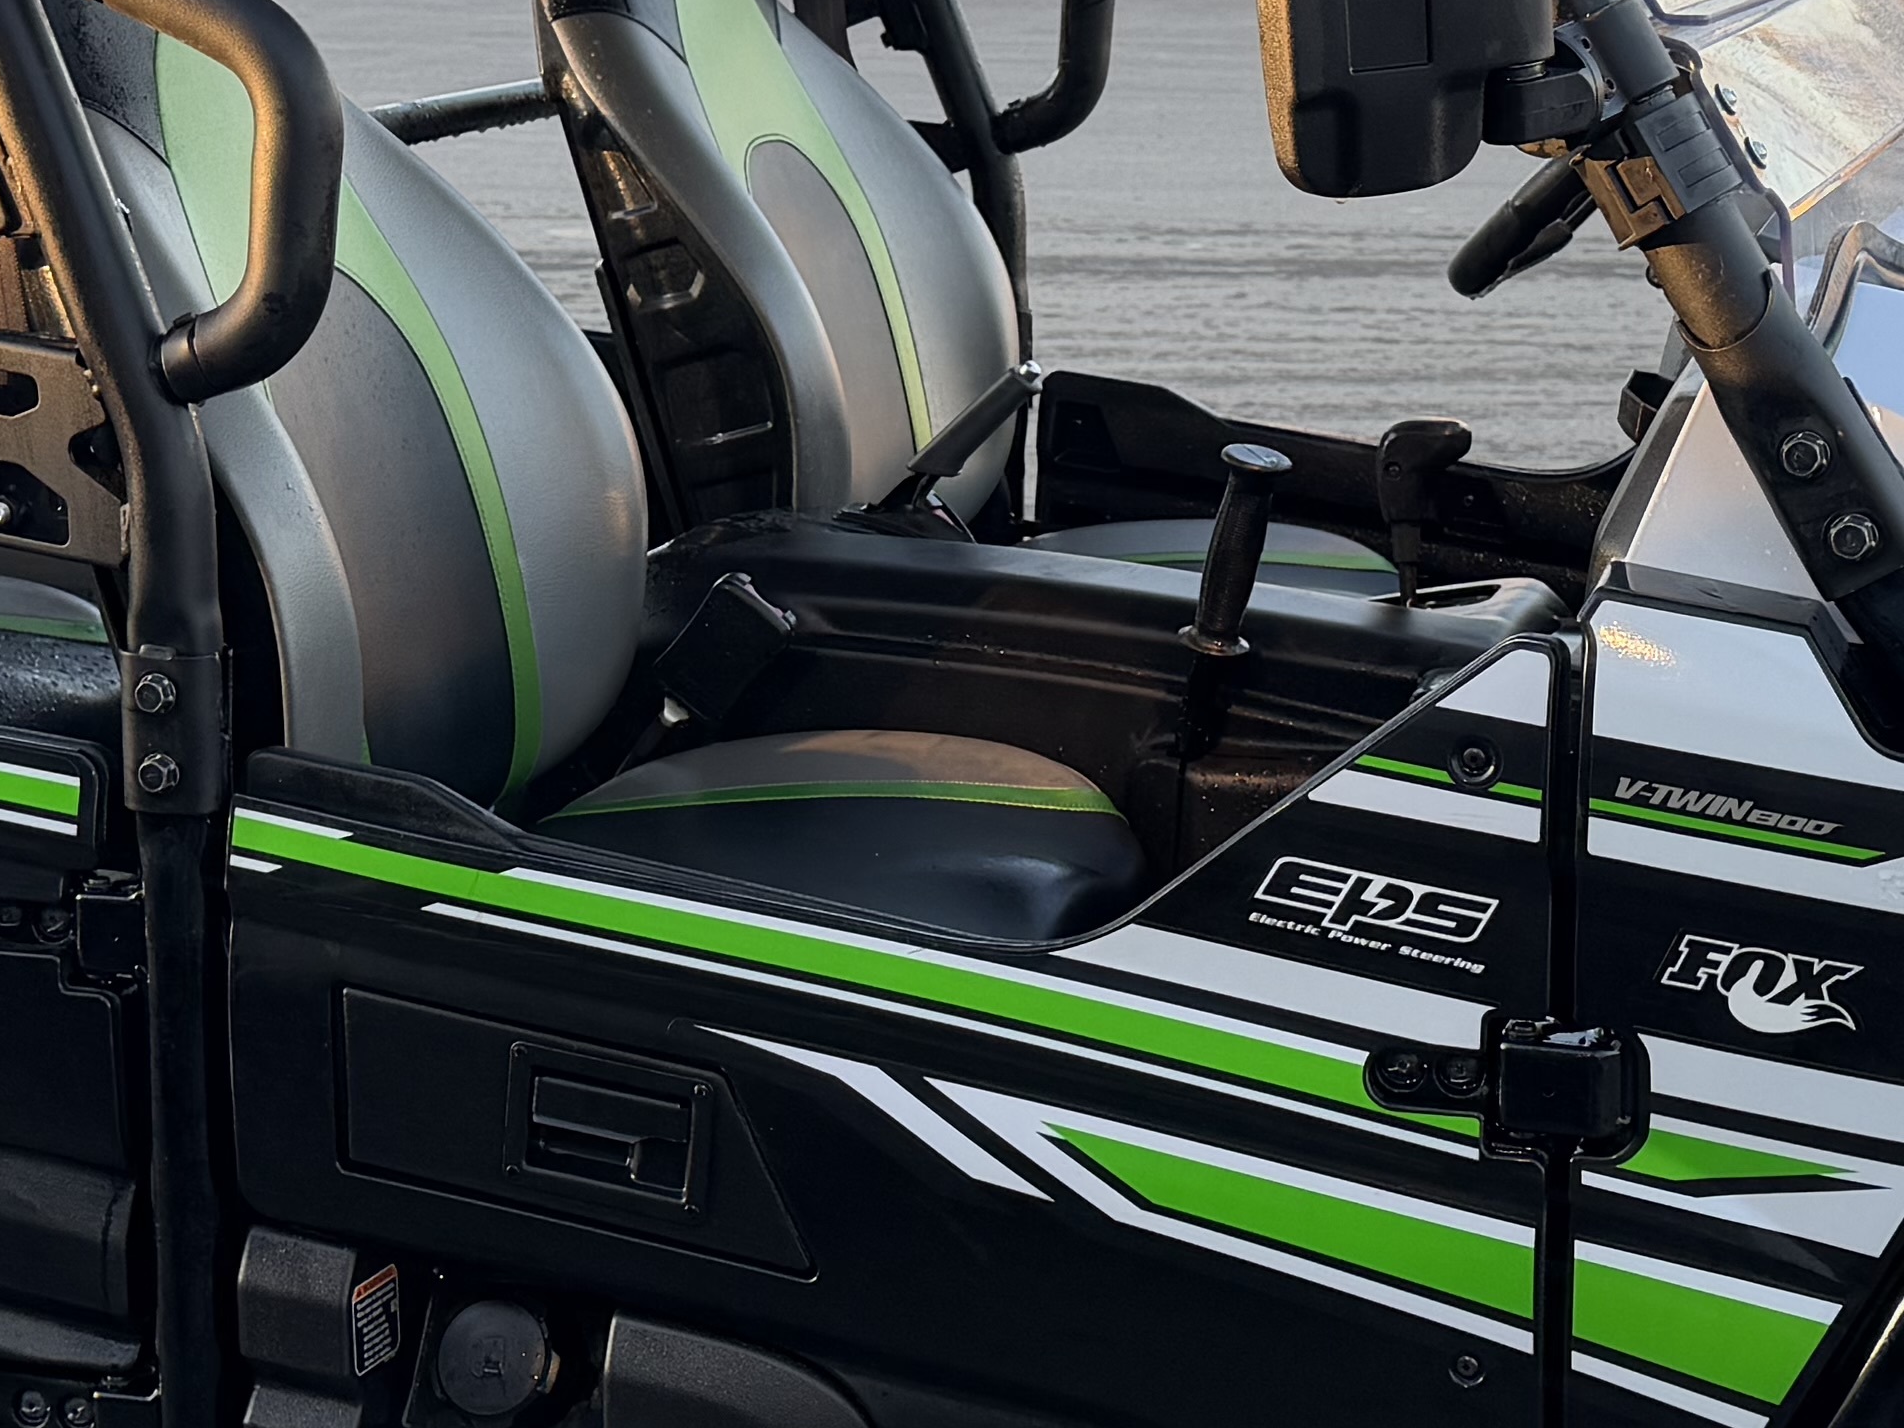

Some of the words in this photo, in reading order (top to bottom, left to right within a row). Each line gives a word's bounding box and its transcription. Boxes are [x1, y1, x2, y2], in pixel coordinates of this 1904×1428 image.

[1253, 856, 1500, 944] EPS
[1248, 911, 1321, 937] Electric
[1327, 929, 1392, 952] Power
[1398, 945, 1486, 974] Steering
[1660, 934, 1865, 1012] FOX
